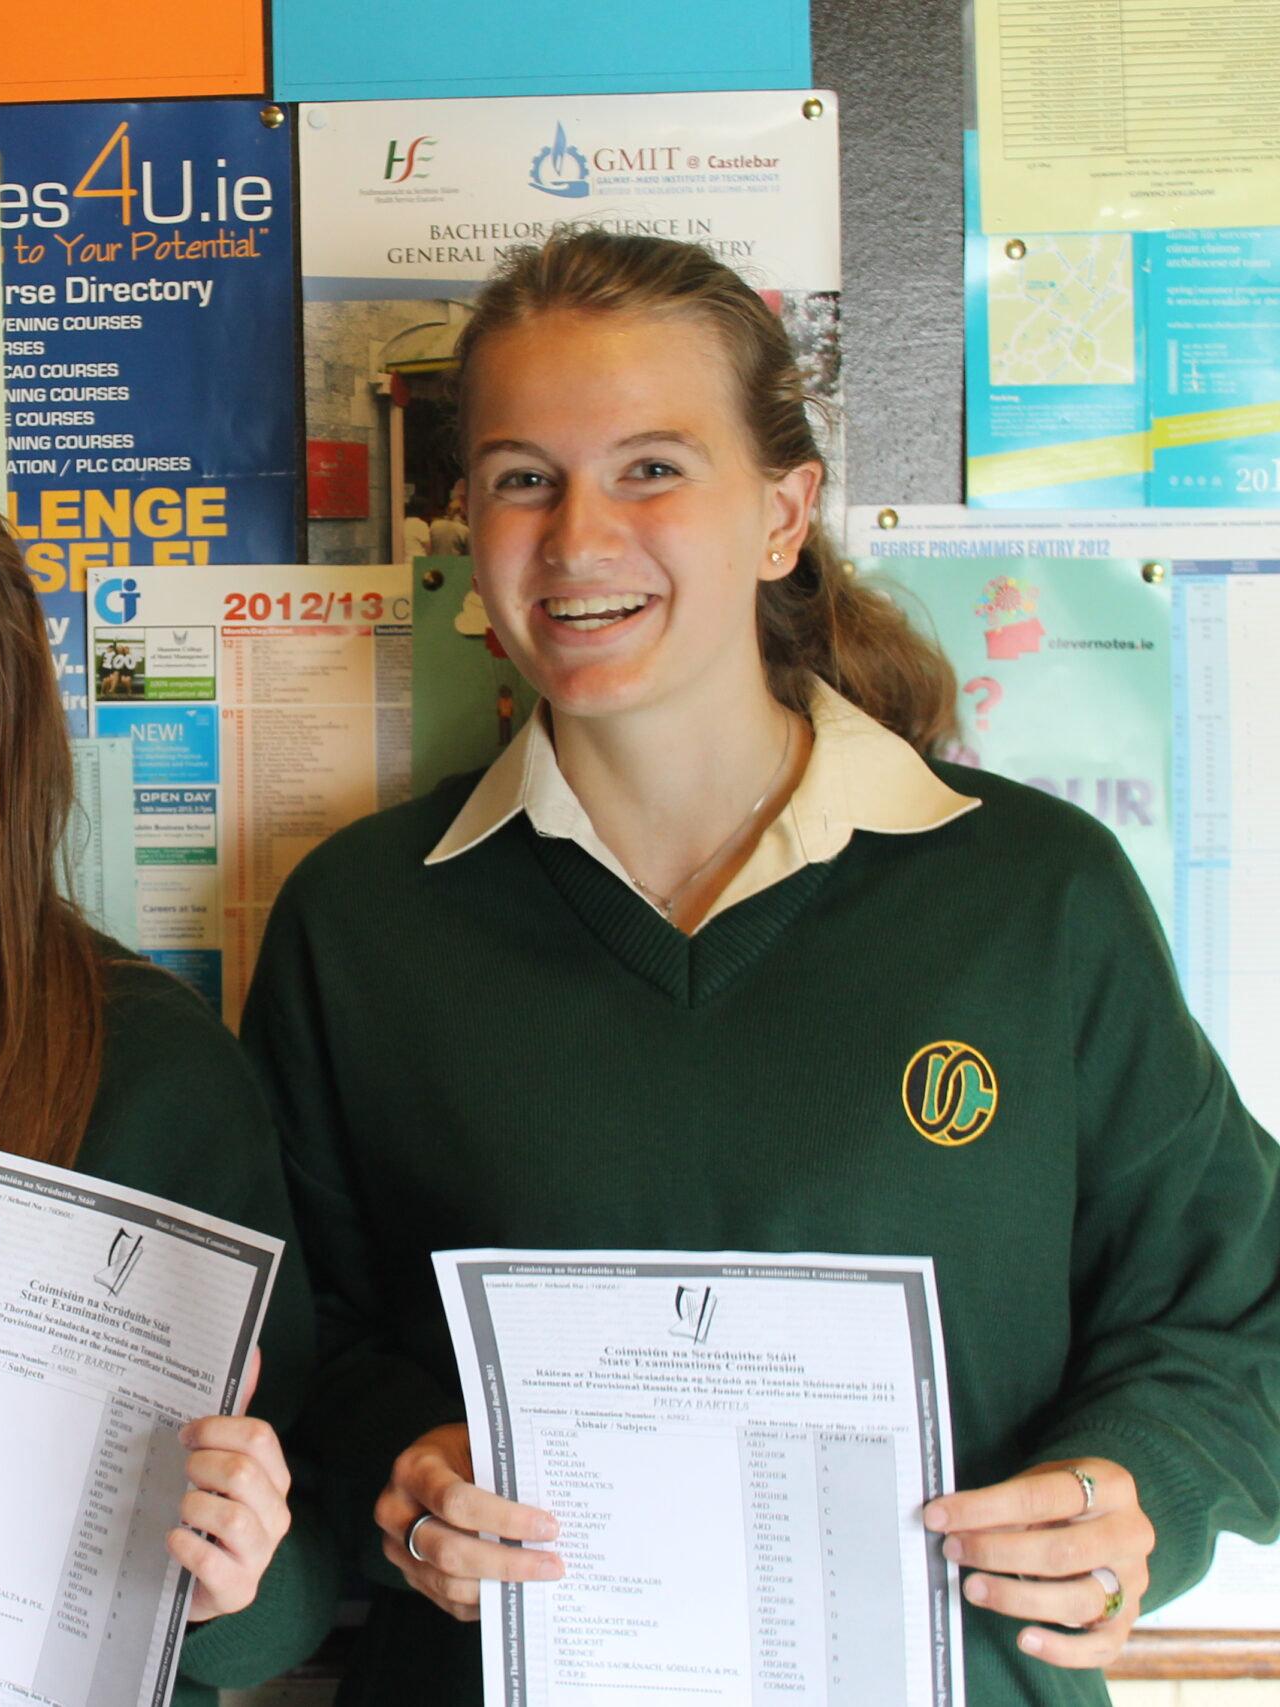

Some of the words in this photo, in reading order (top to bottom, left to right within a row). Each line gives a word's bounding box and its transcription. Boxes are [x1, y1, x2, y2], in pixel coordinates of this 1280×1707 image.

[593, 148, 681, 172] GMIT
[708, 156, 780, 169] Castlebar
[0, 122, 272, 229] es4U.ie
[430, 222, 545, 240] BACHELOR
[688, 219, 712, 234] IN
[15, 234, 44, 264] to
[54, 234, 122, 266] Your
[388, 247, 485, 264] GENERAL
[66, 277, 213, 307] Directory
[63, 316, 142, 330] COURSES
[40, 363, 119, 378] COURSES
[50, 387, 129, 401] COURSES
[16, 411, 95, 426] COURSES
[55, 435, 134, 449] COURSES
[6, 460, 56, 474] ATION
[76, 459, 108, 472] PLC
[112, 457, 191, 472] COURSES
[1236, 458, 1280, 493] 201
[7, 487, 227, 540] LENGE
[870, 541, 927, 558] DEGREE
[929, 540, 1025, 558] PROGAMMES
[1028, 539, 1076, 557] ENTRY
[1078, 539, 1110, 556] 2012
[224, 592, 384, 622] 2012/13
[1049, 637, 1155, 651] clevernotes.ie
[130, 723, 183, 742] NEW!
[140, 793, 180, 802] OPEN
[184, 793, 211, 802] DAY
[143, 904, 176, 913] Careers
[179, 905, 188, 913] at
[722, 1268, 745, 1276] State
[30, 1279, 85, 1305] Coimisiún
[87, 1298, 99, 1308] na
[102, 1301, 151, 1326] Scrúduithe
[20, 1288, 48, 1306] State
[51, 1299, 120, 1328] Examinations
[122, 1322, 172, 1348] Commission
[48, 1327, 78, 1343] Results
[197, 1384, 212, 1395] 2013
[604, 1346, 668, 1358] Coimisiún
[672, 1350, 687, 1358] na
[691, 1349, 762, 1361] Scrúduithe
[766, 1352, 797, 1362] Stáit
[7, 1362, 45, 1380] Subjects
[599, 1357, 630, 1367] State
[634, 1358, 721, 1371] Examinations
[725, 1362, 805, 1374] Commission
[522, 1378, 571, 1388] Statement
[586, 1381, 640, 1391] Provisional
[642, 1384, 679, 1393] Results
[712, 1386, 744, 1395] Junior
[747, 1387, 801, 1398] Certificate
[804, 1391, 868, 1401] Examination
[872, 1393, 895, 1402] 2013
[616, 1421, 657, 1433] Subjects
[548, 1459, 586, 1468] ENGLISH
[550, 1479, 614, 1490] MATHEMATICS
